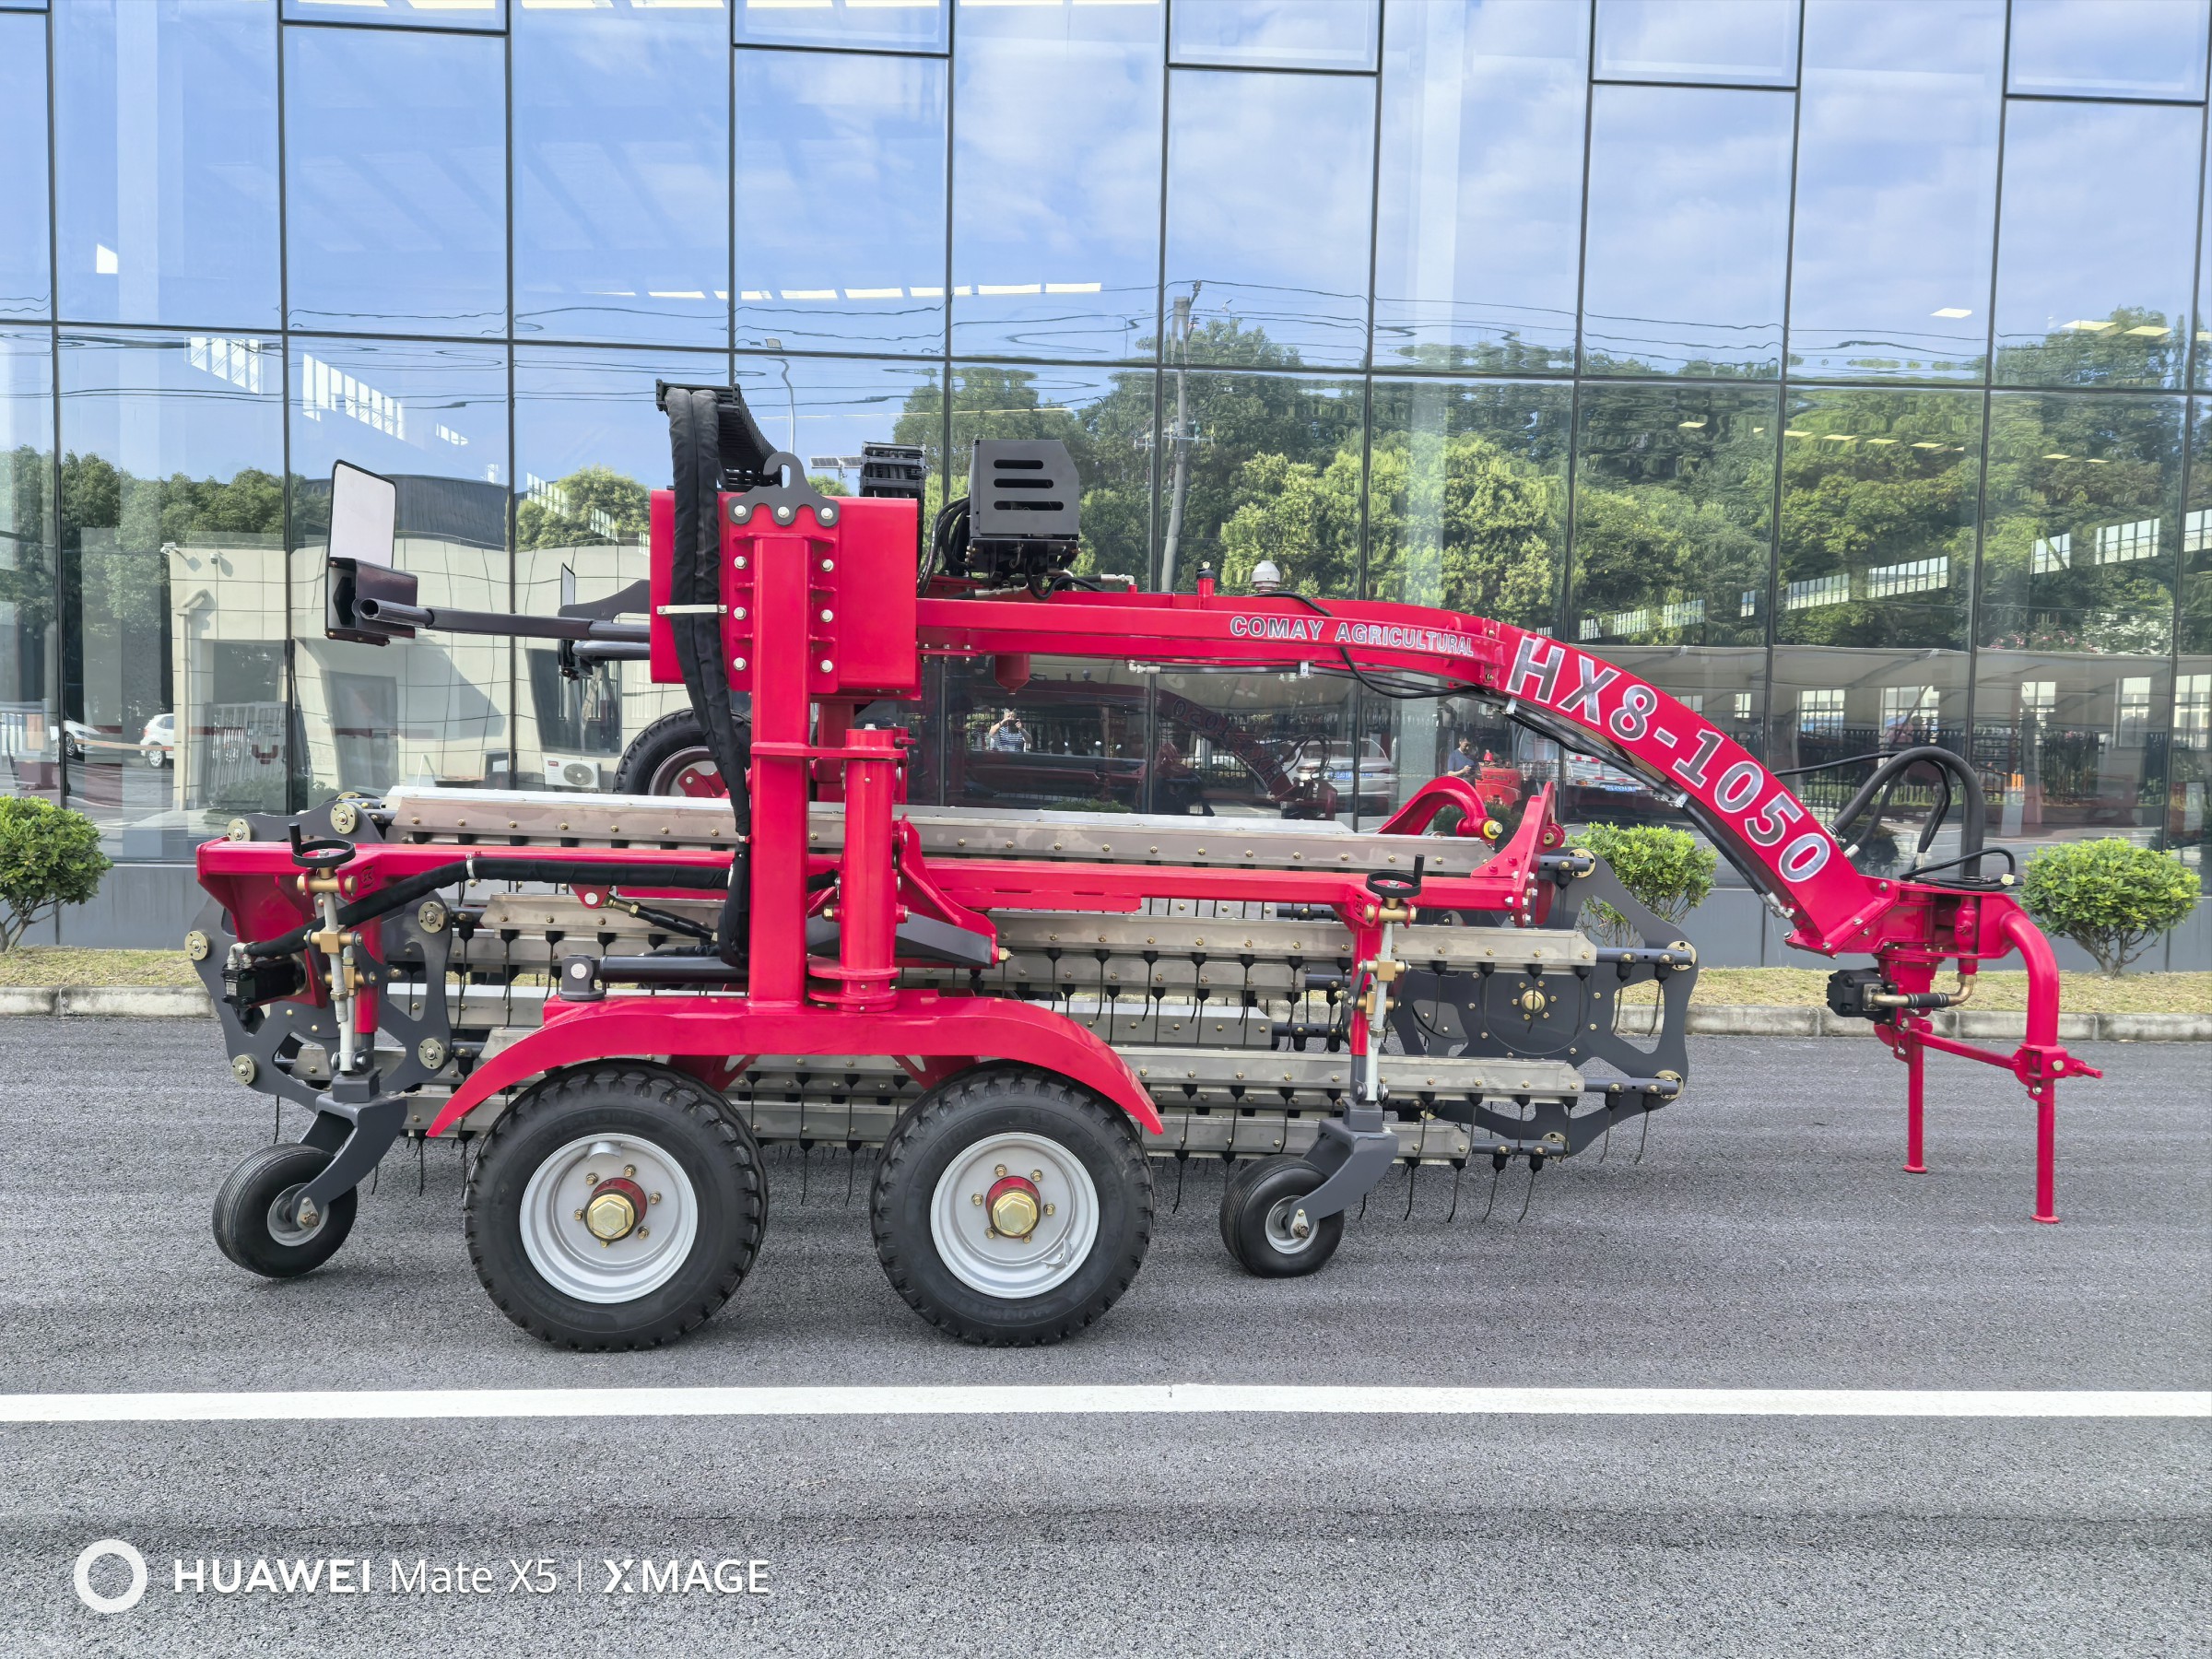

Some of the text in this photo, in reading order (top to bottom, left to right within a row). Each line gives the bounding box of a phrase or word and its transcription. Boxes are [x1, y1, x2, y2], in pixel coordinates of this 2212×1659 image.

[1230, 616, 1474, 656] COMAY AGRICULTURAL
[1506, 635, 1830, 883] HX8-1050
